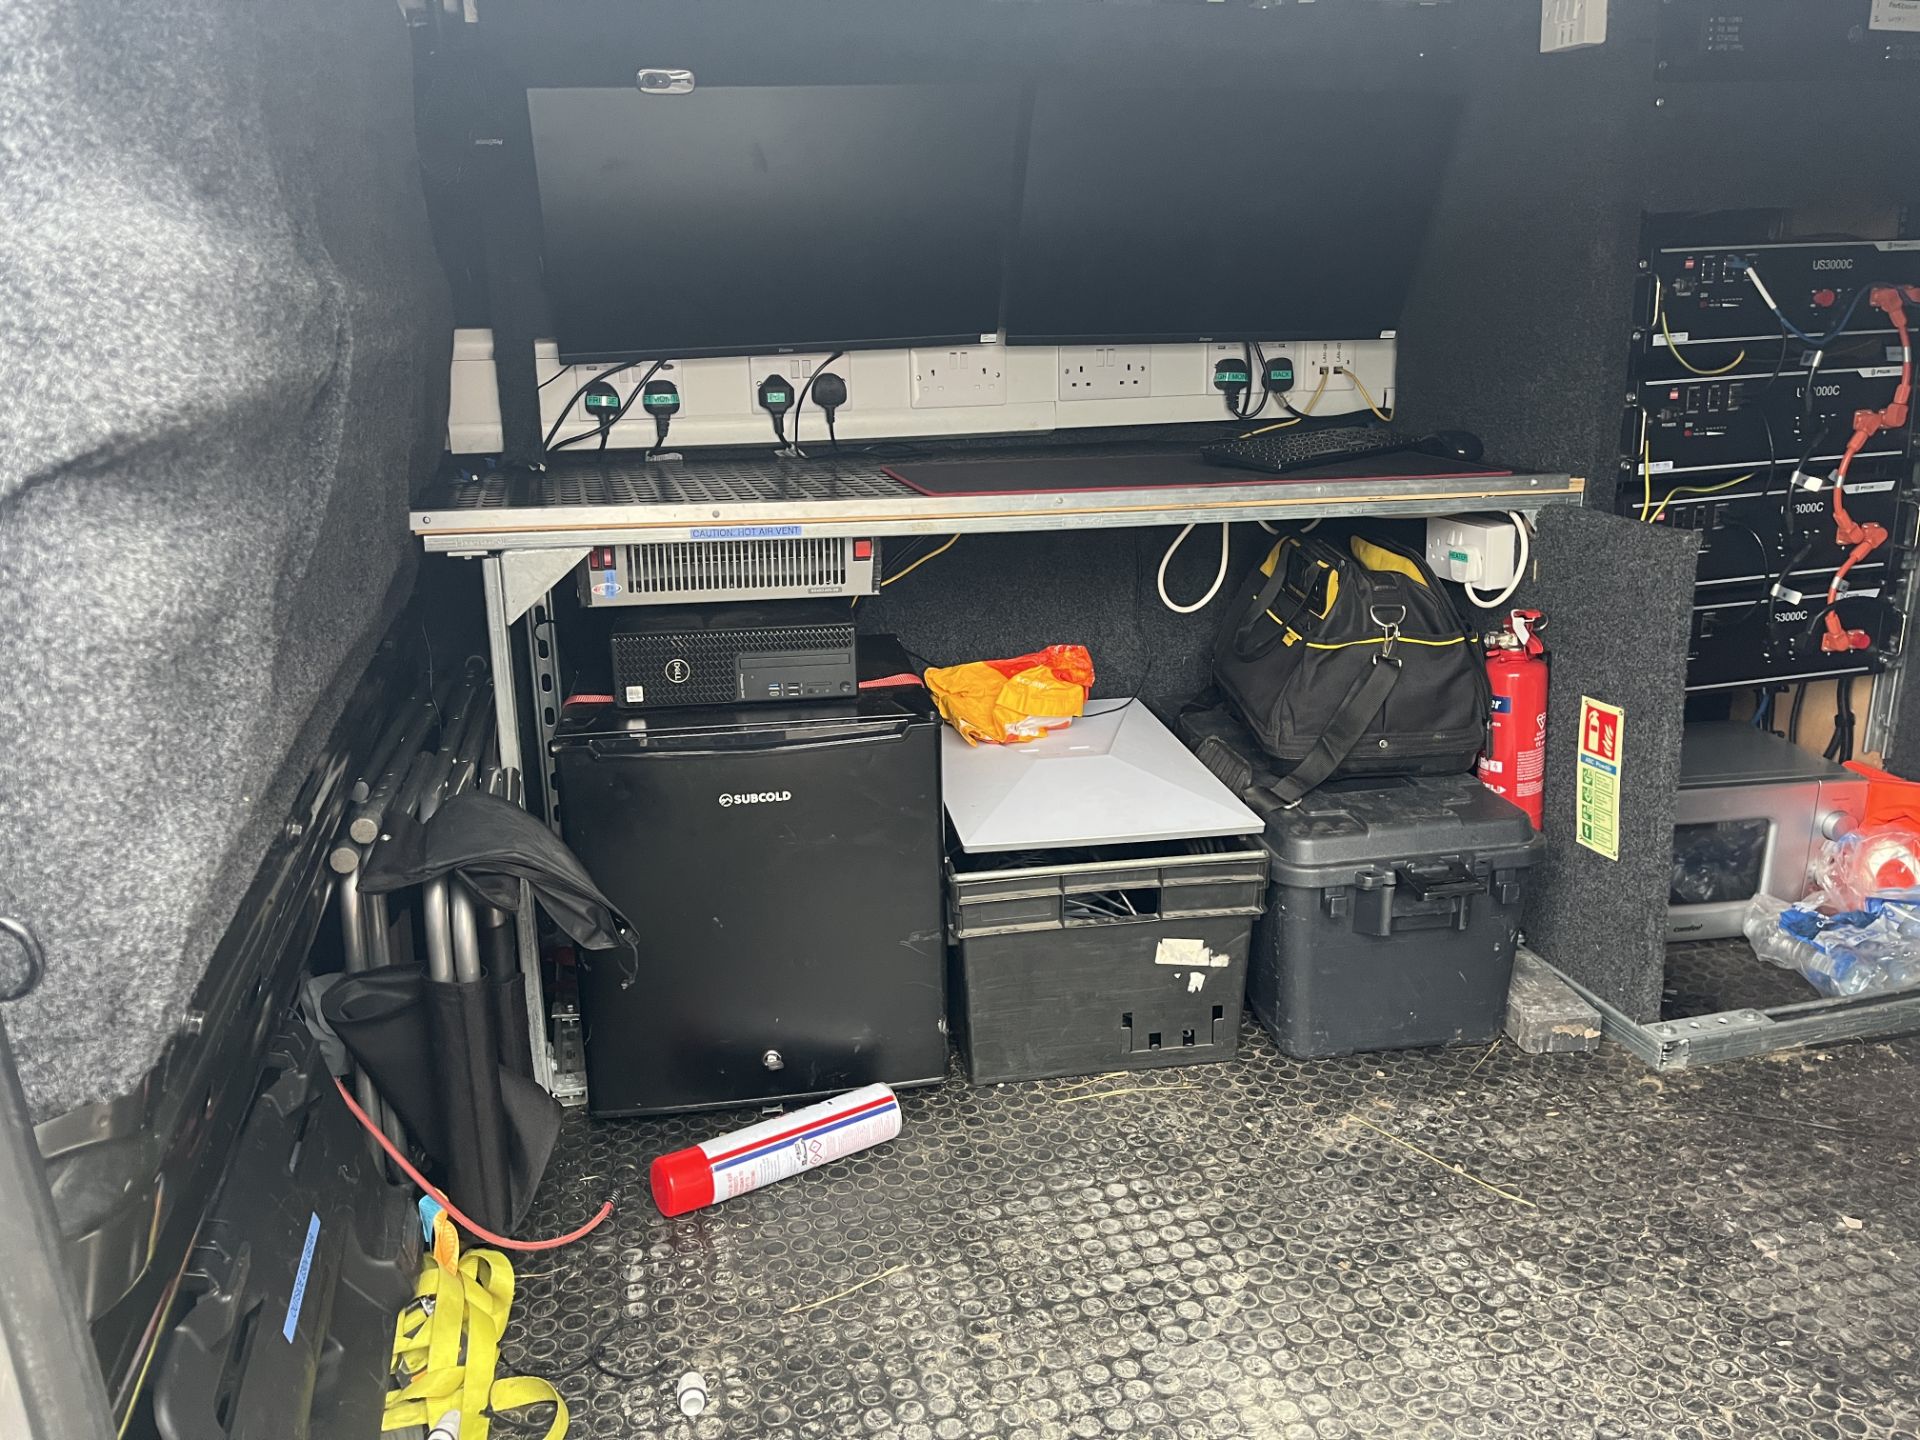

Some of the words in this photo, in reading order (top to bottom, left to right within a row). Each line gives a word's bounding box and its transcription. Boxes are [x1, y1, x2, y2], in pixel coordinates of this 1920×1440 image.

[1812, 259, 1853, 271] US3000C
[1272, 370, 1290, 378] RACK
[1796, 385, 1840, 398] U000C
[738, 527, 758, 537] HOT
[758, 526, 774, 536] AIR
[775, 525, 800, 535] VENT
[733, 790, 792, 804] SUBCOLD
